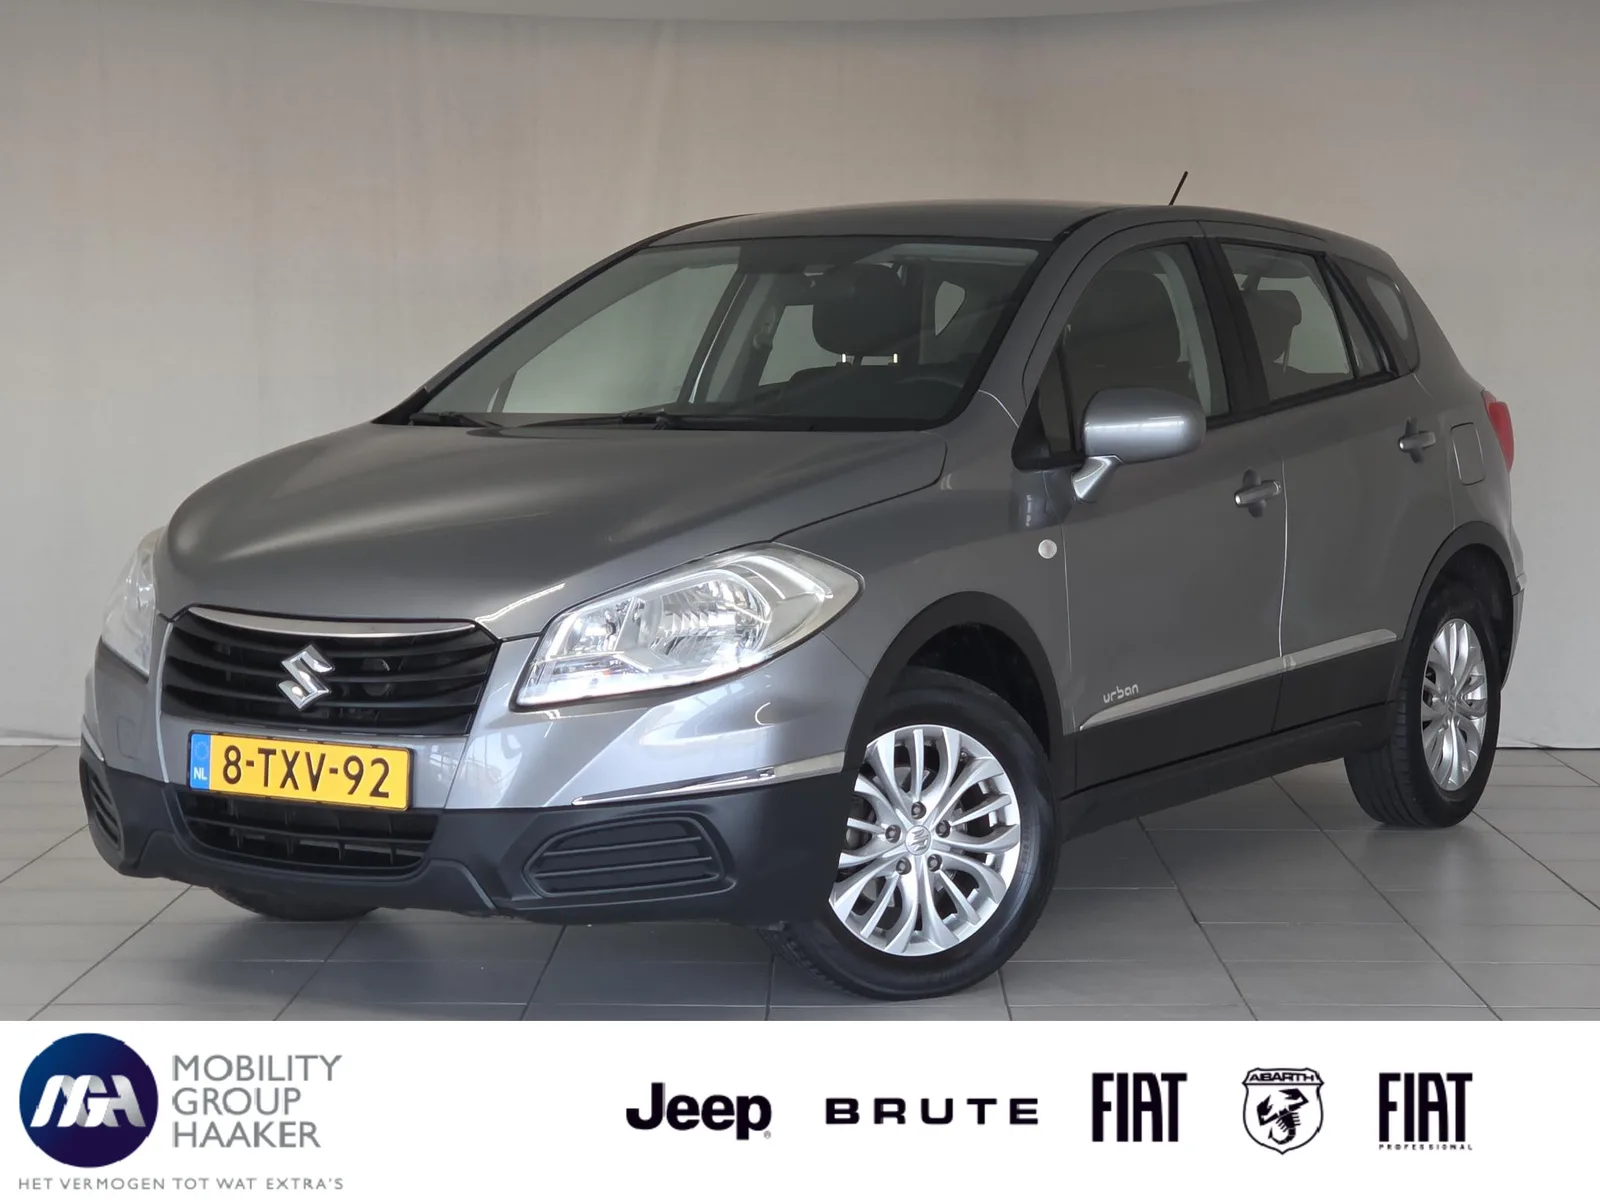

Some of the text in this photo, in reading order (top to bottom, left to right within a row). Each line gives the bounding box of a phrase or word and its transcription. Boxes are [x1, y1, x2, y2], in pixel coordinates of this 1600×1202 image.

[1102, 683, 1139, 704] urban
[193, 766, 208, 781] NL
[222, 744, 390, 799] 8-TXV-92
